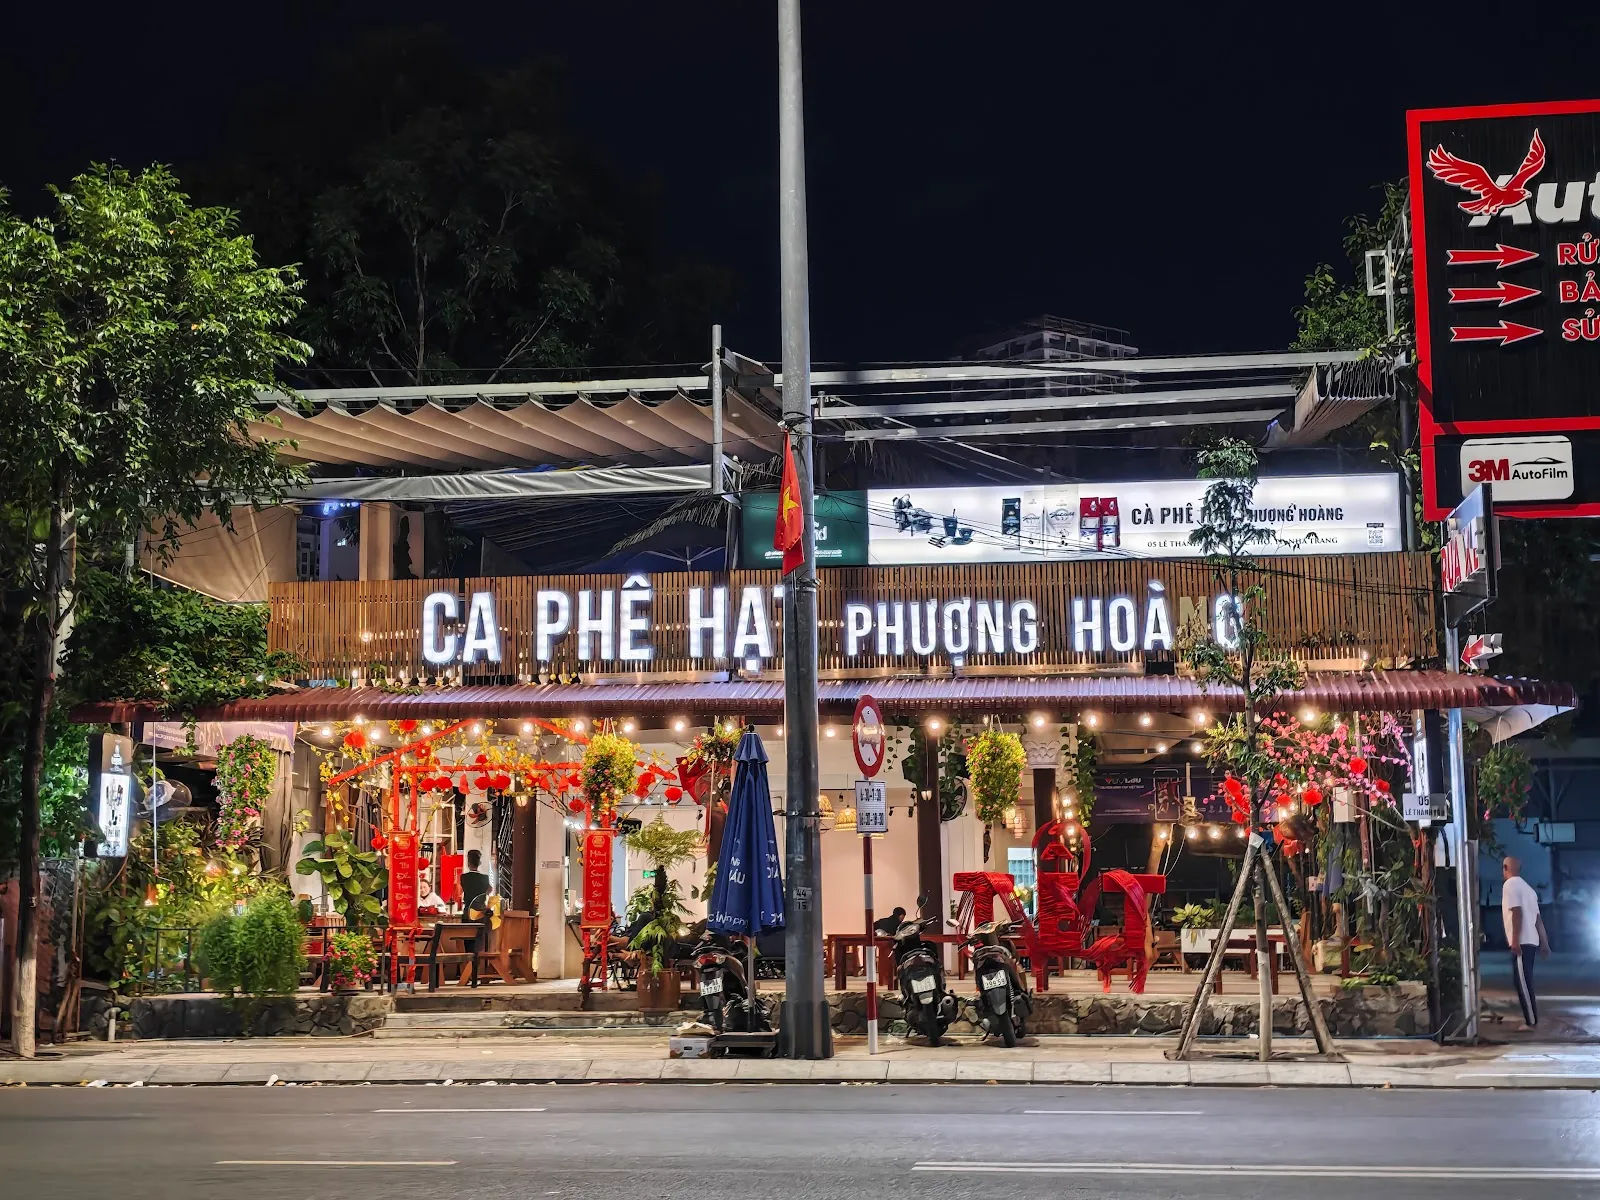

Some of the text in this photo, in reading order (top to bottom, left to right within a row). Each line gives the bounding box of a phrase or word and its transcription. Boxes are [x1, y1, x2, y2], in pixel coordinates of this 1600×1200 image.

[1557, 232, 1600, 266] RỬ
[1468, 458, 1568, 482] 3M AutoFilm
[1131, 503, 1154, 525] CÀ
[1160, 502, 1194, 524] PHÊ
[1298, 504, 1344, 522] HOÀNG
[422, 591, 501, 664] CA
[537, 575, 654, 662] PHÊ
[846, 597, 1038, 666] PHƯỢNG
[1418, 796, 1429, 806] 05
